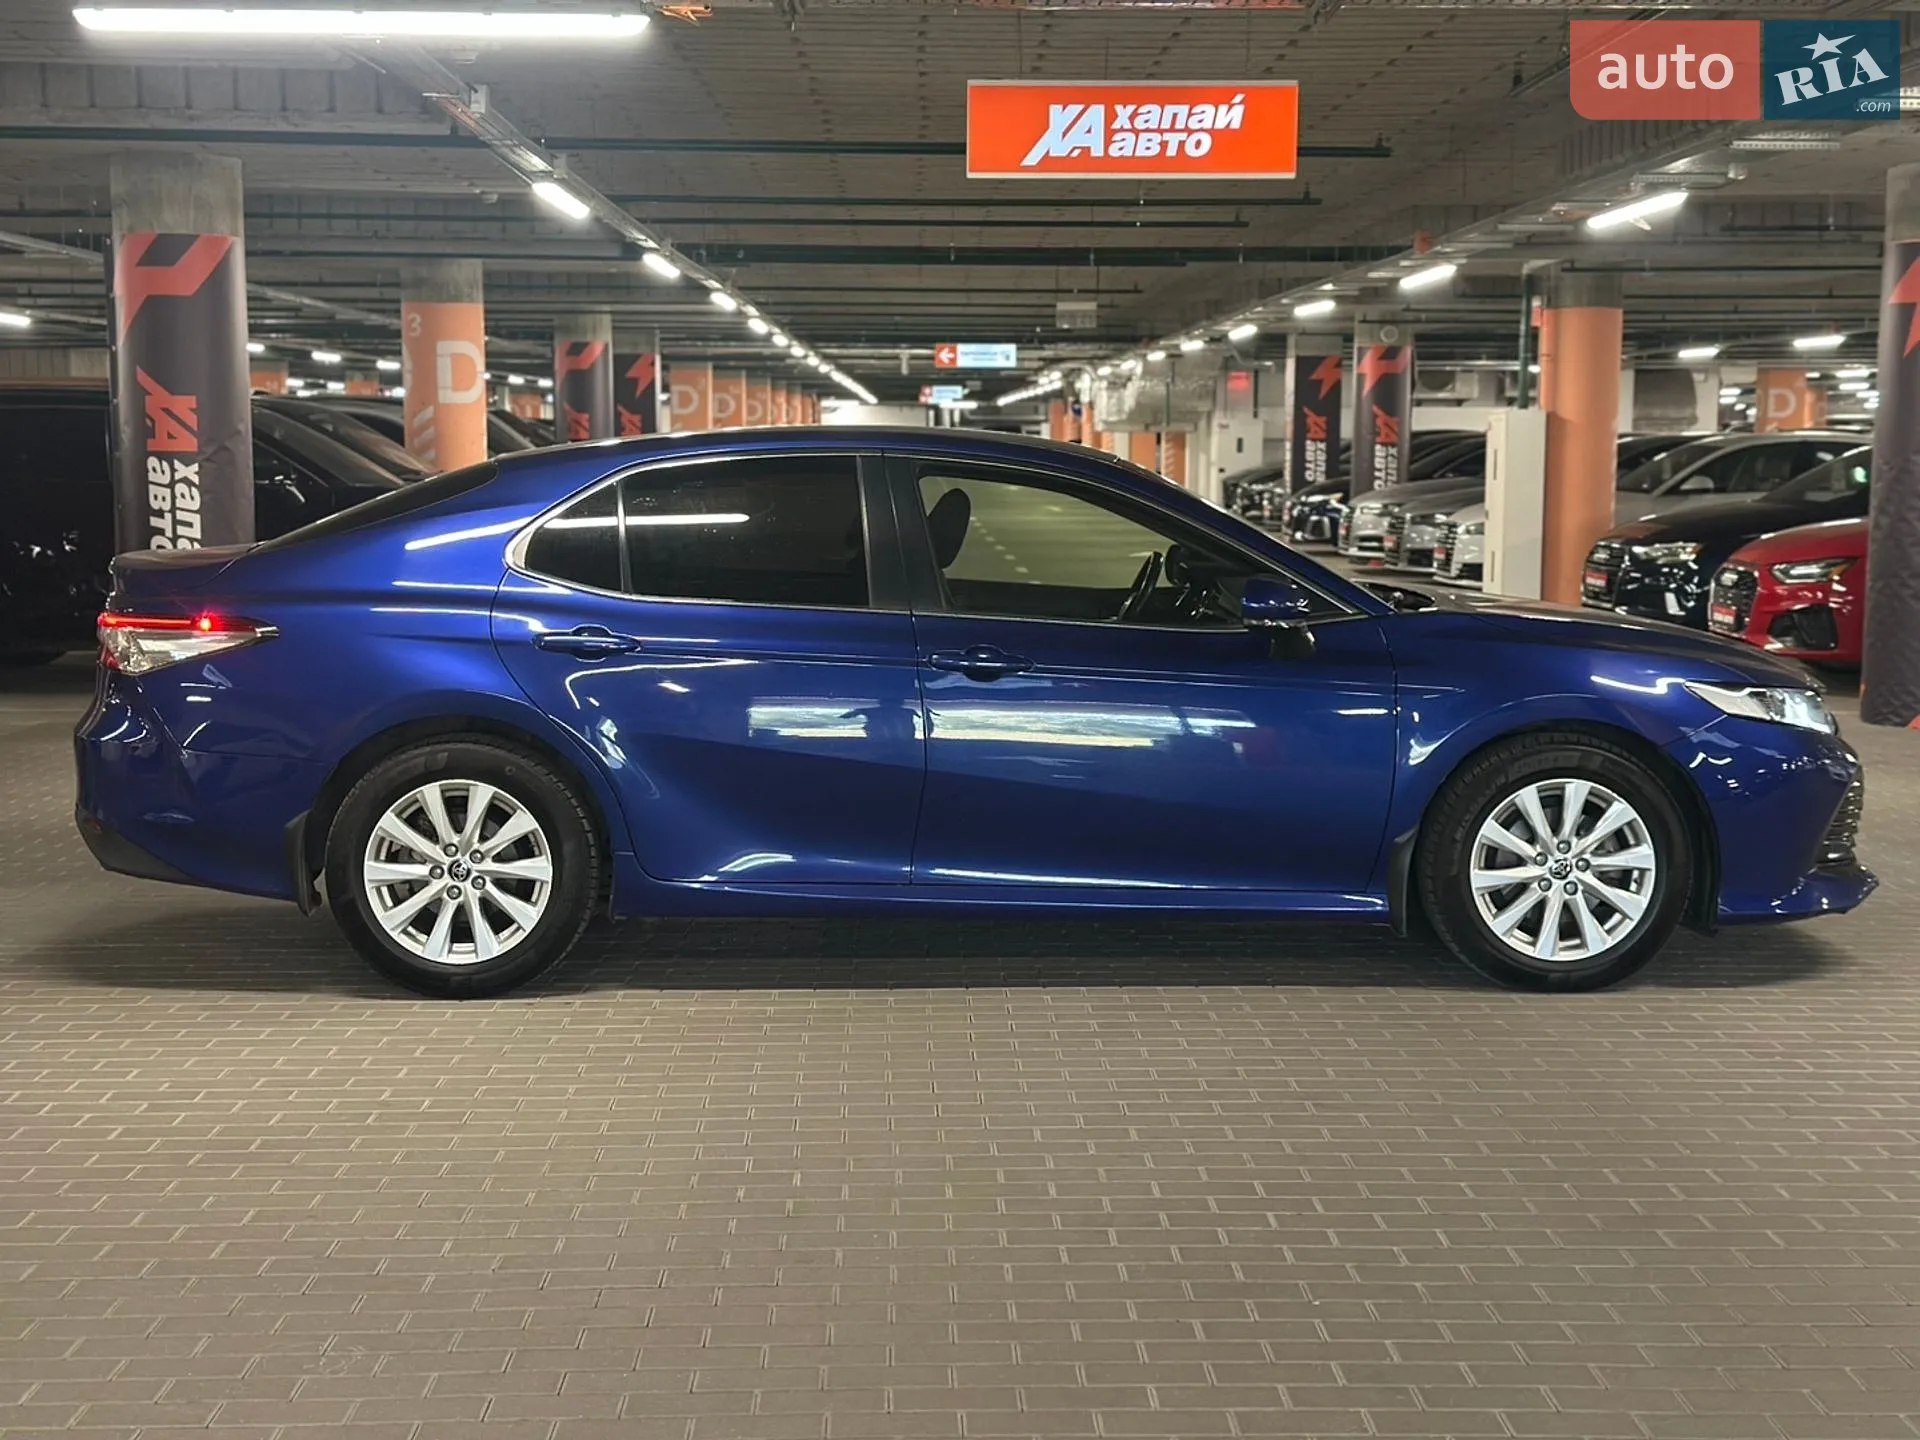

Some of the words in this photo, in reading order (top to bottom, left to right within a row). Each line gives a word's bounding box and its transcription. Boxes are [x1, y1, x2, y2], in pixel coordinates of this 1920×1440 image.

[1111, 94, 1245, 130] хапай
[1108, 132, 1212, 157] авто
[436, 340, 484, 404] D
[671, 384, 699, 415] D
[1767, 388, 1797, 418] D
